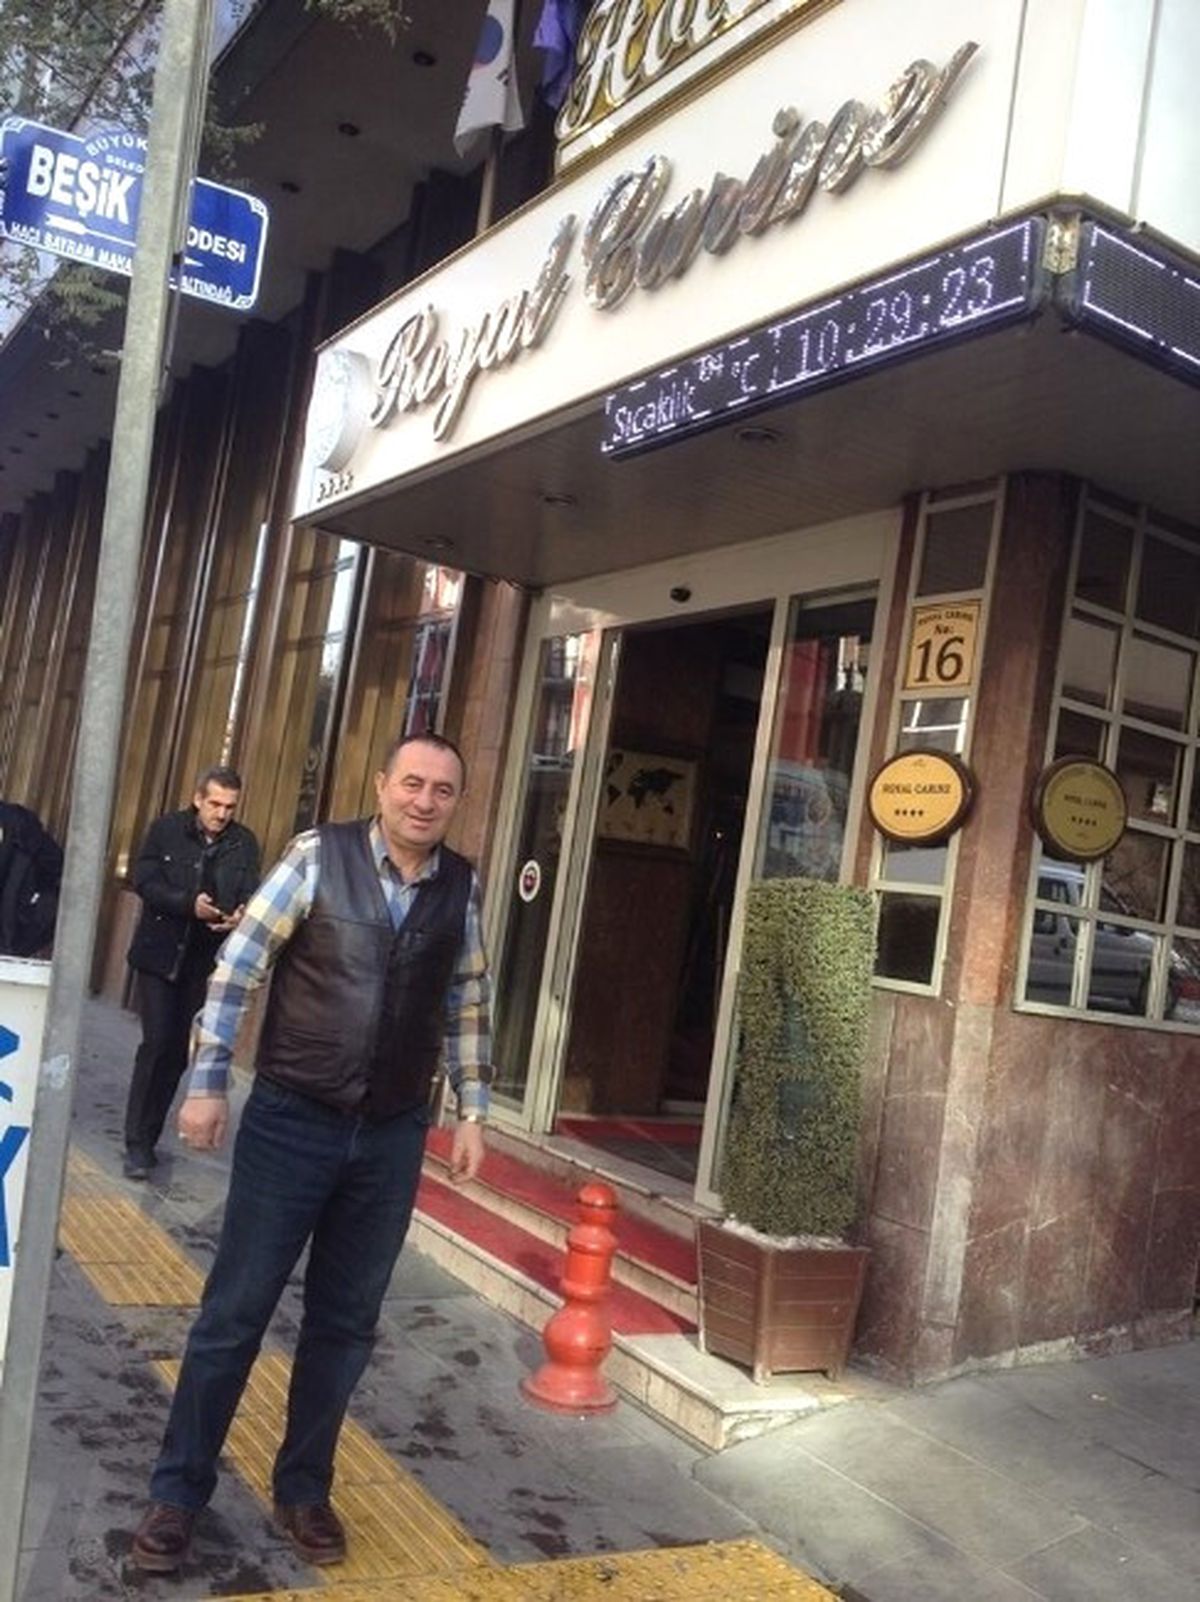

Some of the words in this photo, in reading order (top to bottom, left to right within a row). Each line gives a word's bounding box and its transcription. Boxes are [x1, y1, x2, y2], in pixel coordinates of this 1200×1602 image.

[370, 212, 572, 442] Royal
[583, 41, 978, 311] Carine
[914, 636, 965, 683] 16
